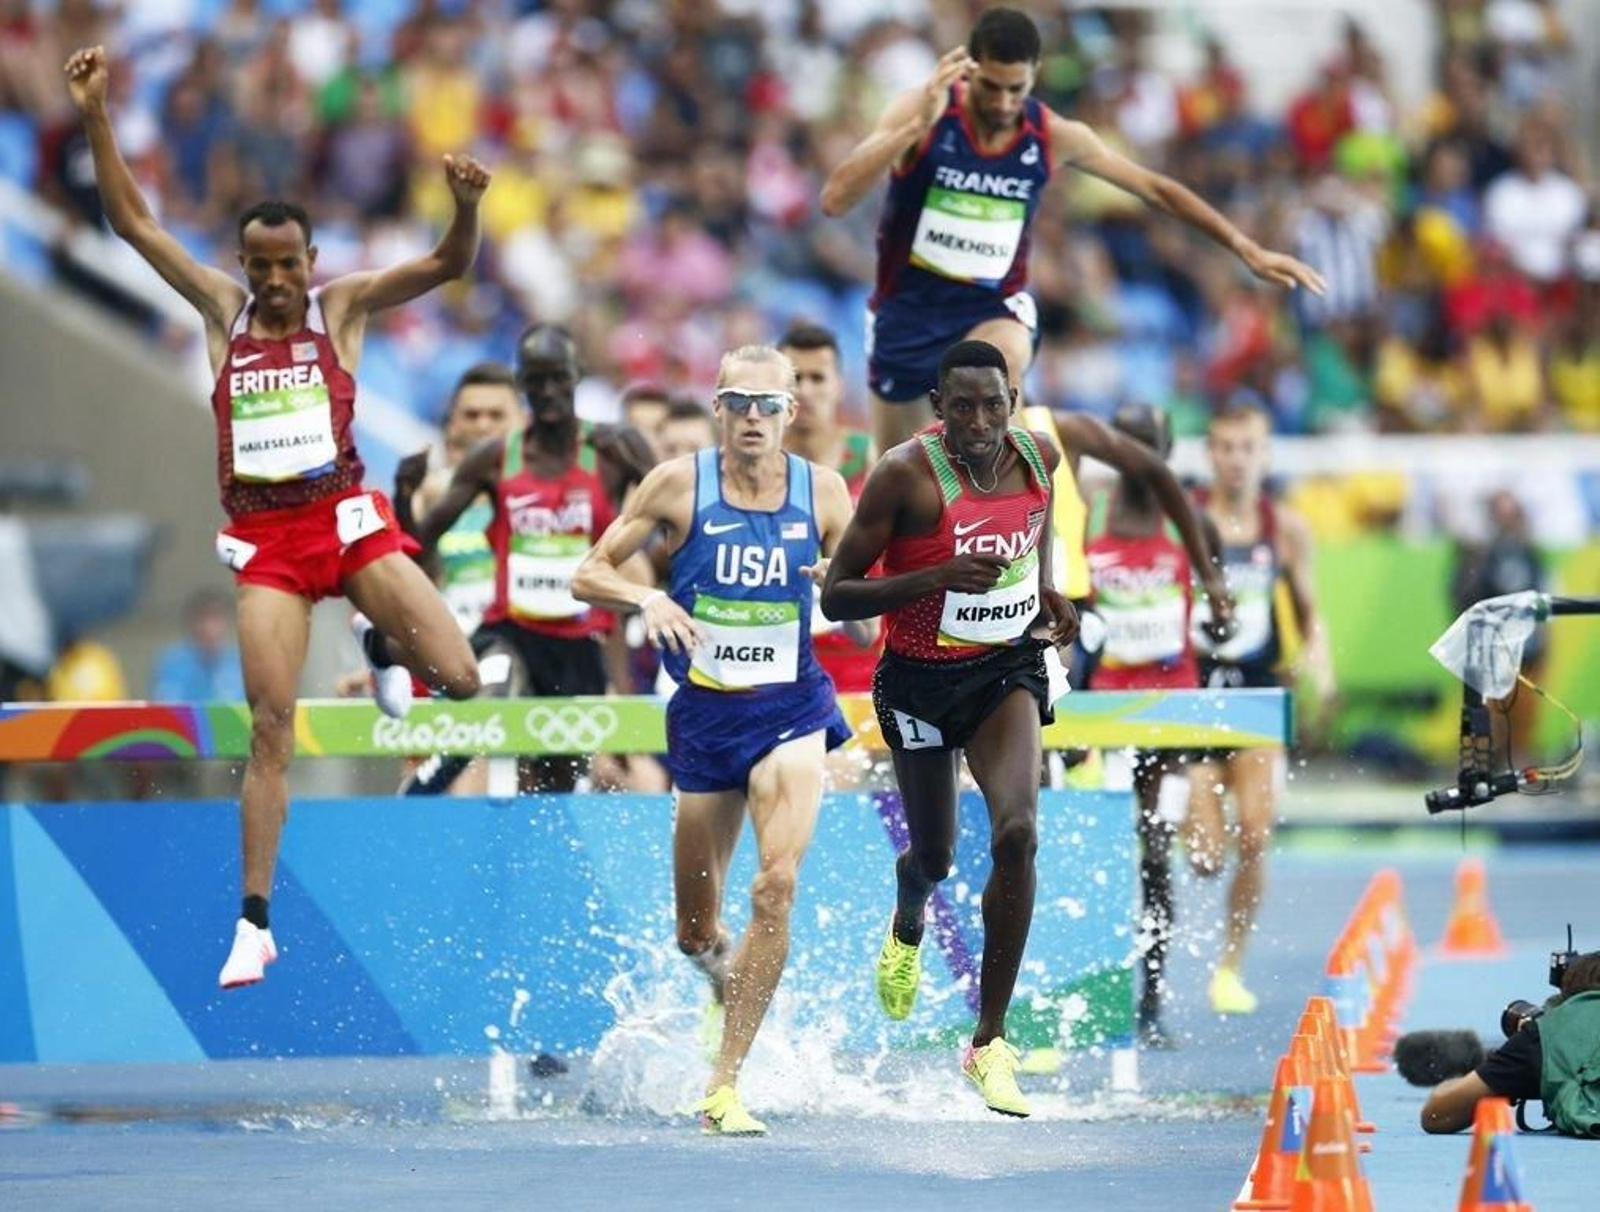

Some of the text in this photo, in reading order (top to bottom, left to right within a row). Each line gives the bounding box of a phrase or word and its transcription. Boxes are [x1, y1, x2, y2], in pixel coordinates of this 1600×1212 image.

[935, 166, 1034, 199] FRANCE
[230, 364, 324, 396] ERITREA
[351, 508, 363, 529] 7
[226, 548, 237, 570] 7
[715, 543, 788, 587] USA
[956, 594, 1036, 622] KIPRUTO
[714, 645, 775, 662] JAGER
[372, 713, 506, 749] Rio2016
[906, 718, 925, 743] 1
